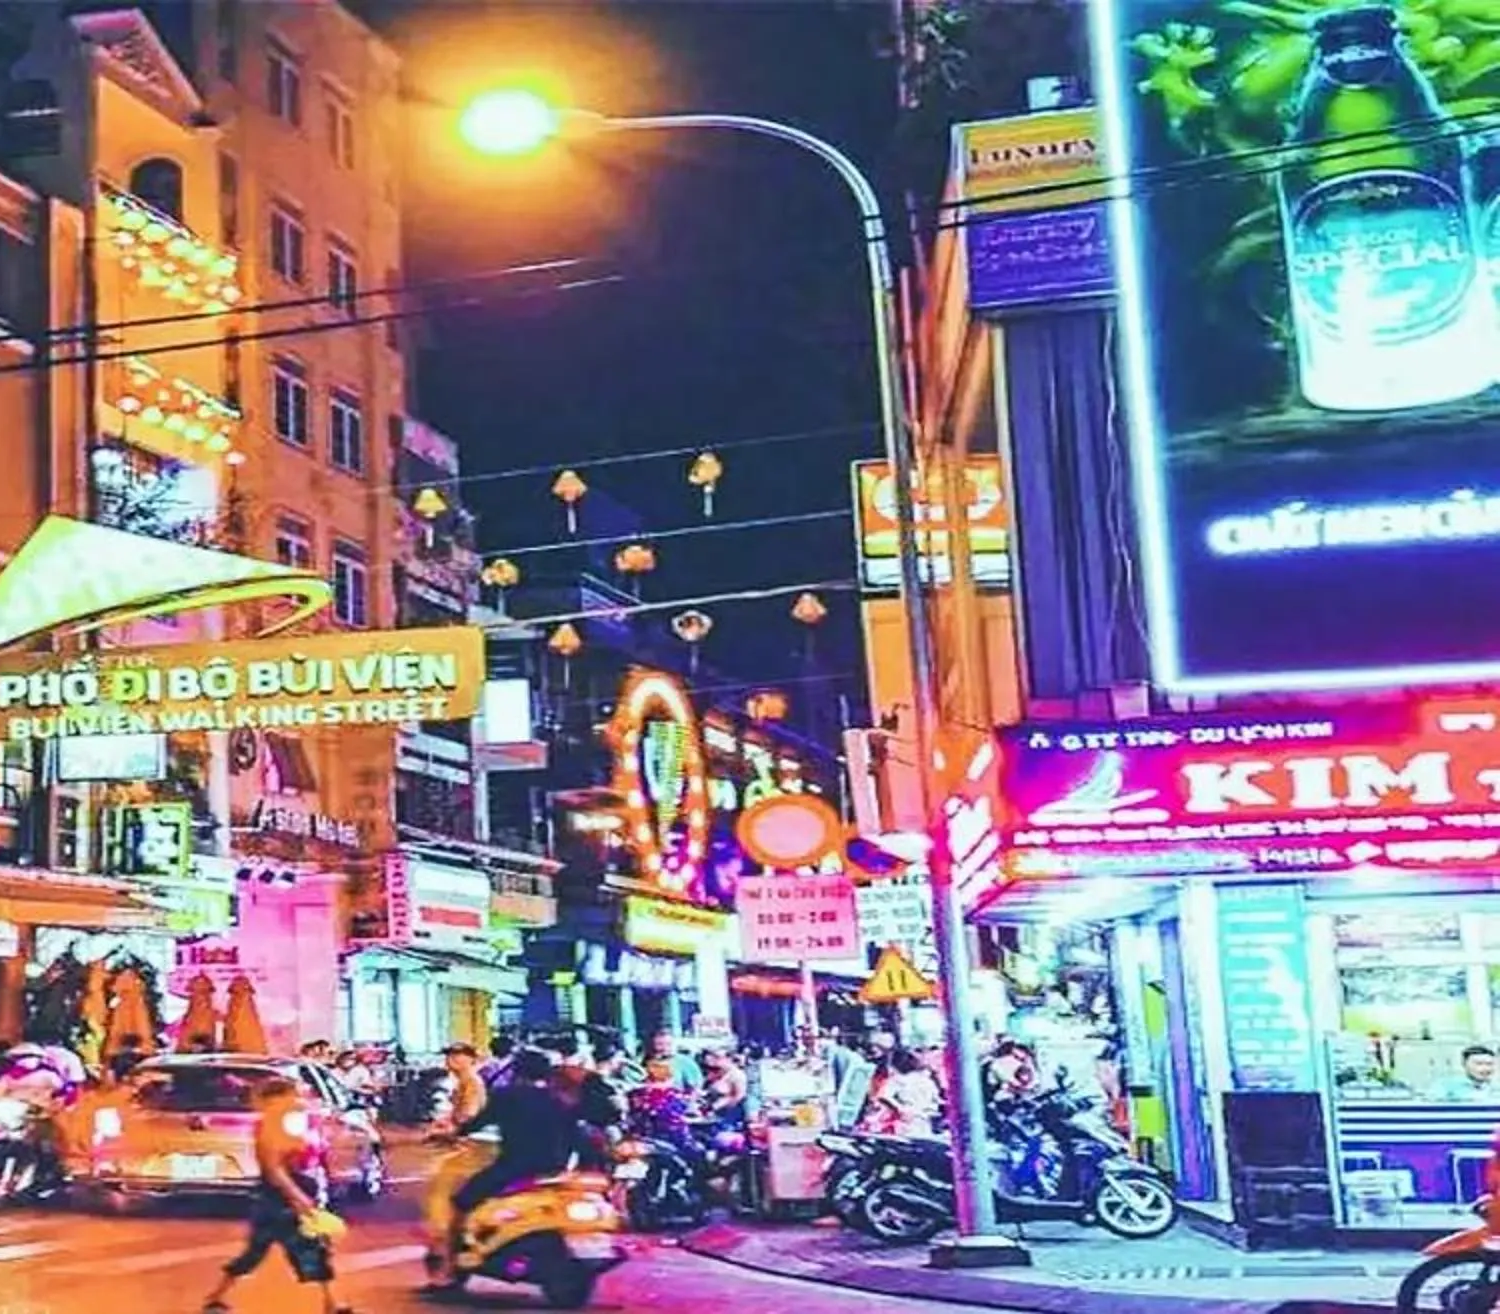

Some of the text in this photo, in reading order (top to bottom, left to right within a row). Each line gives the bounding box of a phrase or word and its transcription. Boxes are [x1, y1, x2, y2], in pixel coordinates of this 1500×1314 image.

[1295, 235, 1463, 274] SPECIAL
[158, 702, 317, 730] WALKING
[321, 697, 449, 723] STREET
[1182, 752, 1456, 813] KIM
